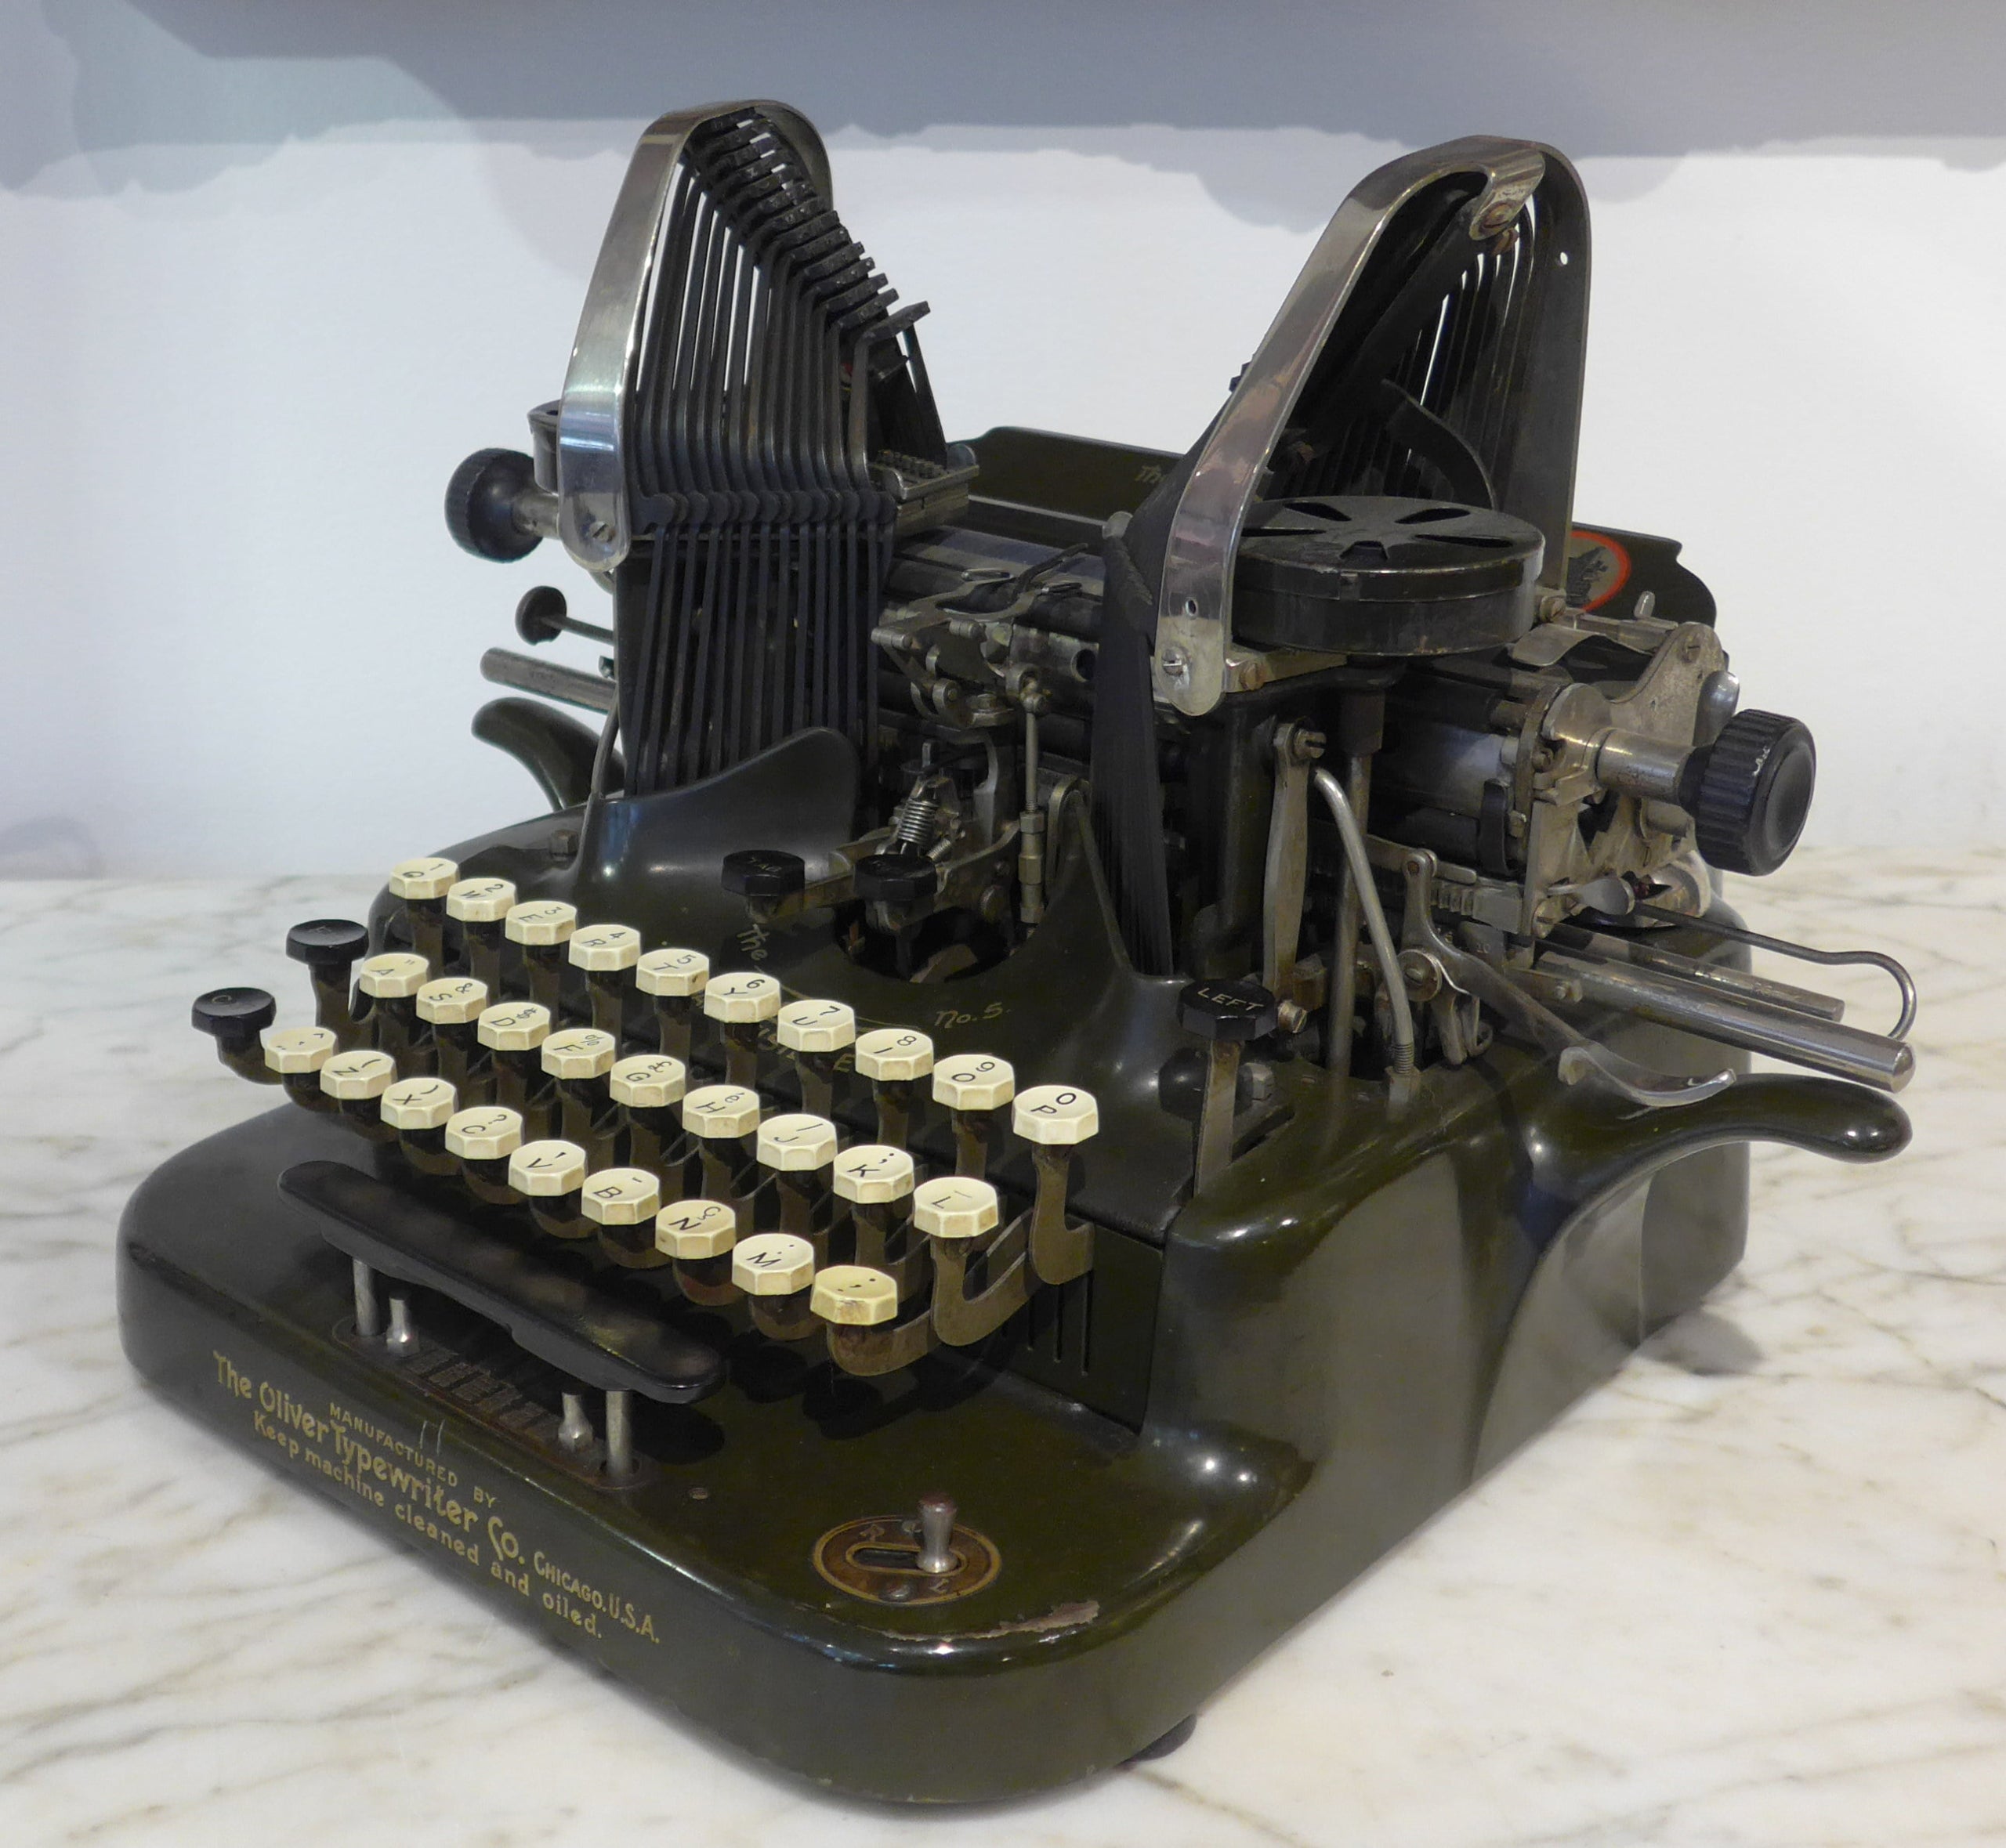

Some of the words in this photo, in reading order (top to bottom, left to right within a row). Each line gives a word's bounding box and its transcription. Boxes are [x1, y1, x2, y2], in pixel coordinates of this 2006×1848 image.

[484, 883, 504, 894] 2
[460, 890, 487, 899] W
[544, 906, 563, 916] 3
[518, 913, 544, 923] E
[609, 931, 627, 940] 4
[581, 938, 607, 947] R
[676, 954, 697, 964] 5
[370, 967, 396, 977] A
[653, 962, 679, 971] T
[454, 982, 473, 994] &
[745, 978, 766, 989] 6
[722, 986, 748, 996] Y
[428, 992, 453, 1002] S
[1196, 986, 1266, 1011] LEFT
[515, 1007, 538, 1019] $
[819, 1005, 841, 1017] 7
[491, 1016, 516, 1027] D
[791, 1016, 818, 1026] U
[896, 1035, 917, 1047] 8
[552, 1043, 584, 1052] F
[331, 1066, 360, 1076] Z
[975, 1061, 996, 1072] 9
[625, 1072, 651, 1083] G
[950, 1072, 976, 1083] O
[393, 1094, 422, 1105] X
[694, 1101, 726, 1114] H
[1030, 1105, 1058, 1116] P
[487, 1113, 508, 1125] ?
[461, 1124, 486, 1135] C
[525, 1157, 553, 1168] V
[845, 1163, 881, 1177] K
[592, 1186, 623, 1199] B
[931, 1195, 952, 1209] L
[668, 1217, 702, 1231] N
[745, 1252, 782, 1268] M
[212, 1350, 252, 1400] The
[259, 1381, 330, 1445] Oliver
[330, 1419, 480, 1533] Typewriter
[487, 1516, 526, 1562] Co.
[329, 1401, 458, 1488] MANUFACTURED
[473, 1486, 499, 1509] BY
[253, 1409, 300, 1460] Keep
[304, 1447, 385, 1508] machine
[394, 1503, 480, 1567] cleaned
[491, 1561, 530, 1597] and
[542, 1592, 603, 1640] oiled.
